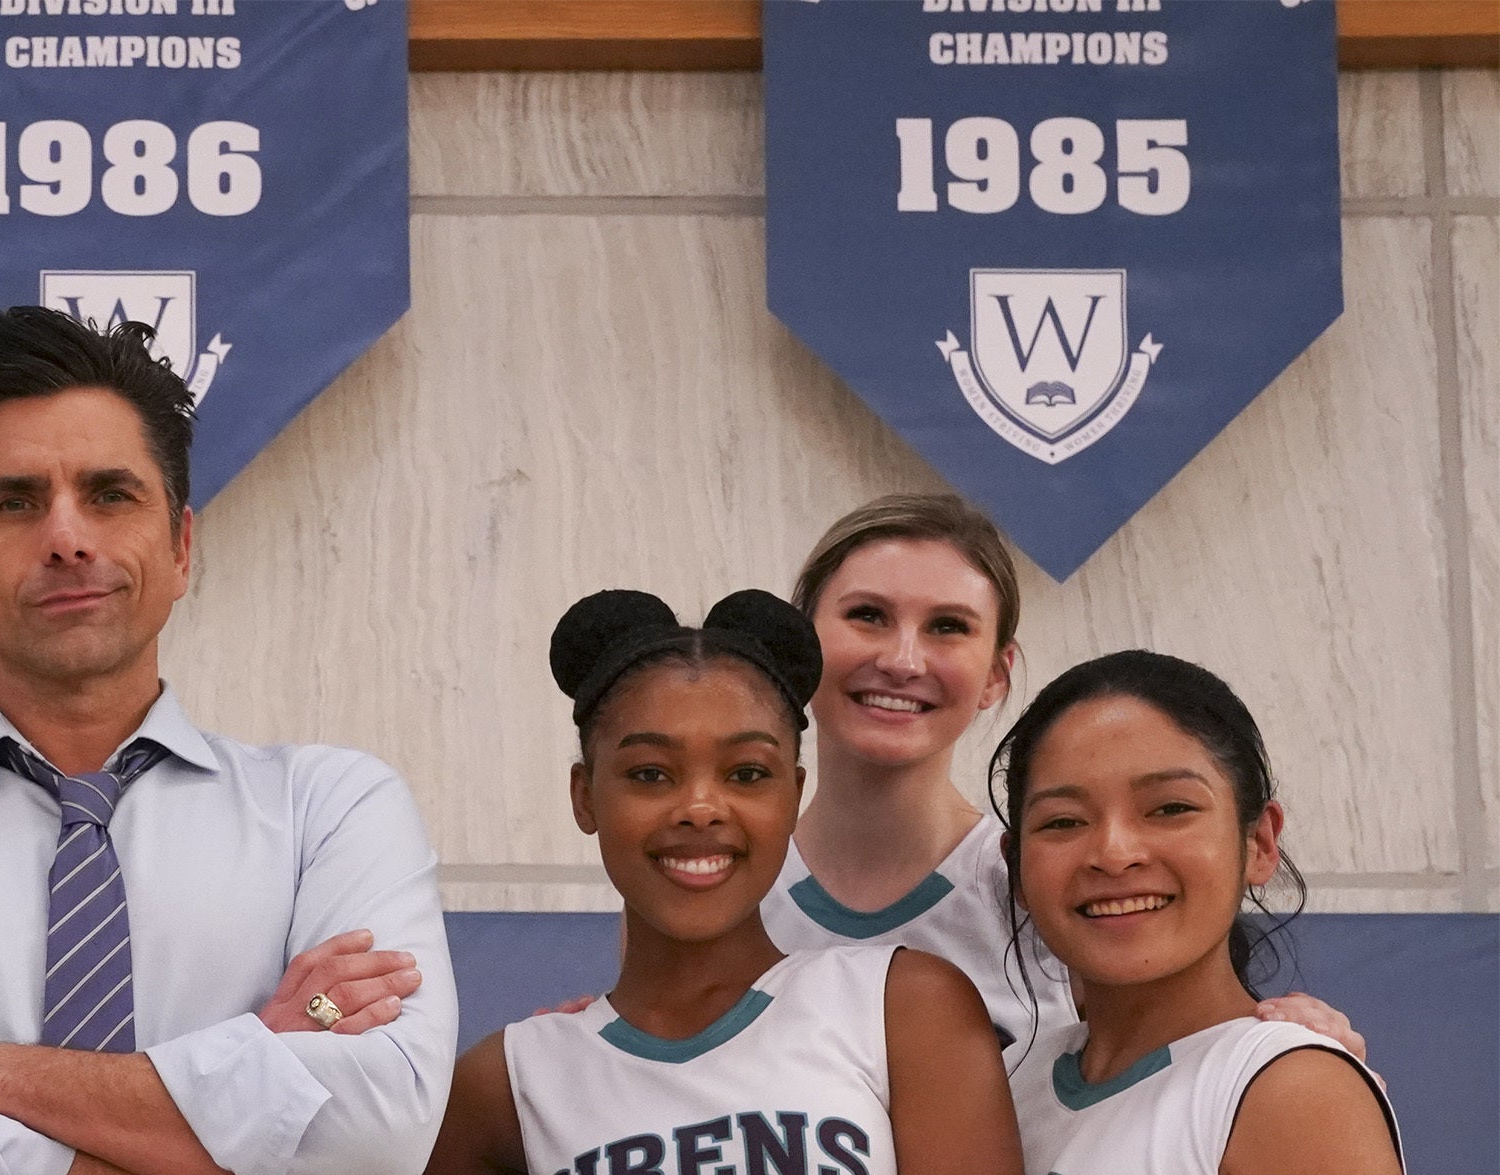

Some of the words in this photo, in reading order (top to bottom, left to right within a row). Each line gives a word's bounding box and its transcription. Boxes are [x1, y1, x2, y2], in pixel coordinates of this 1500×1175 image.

[5, 36, 242, 69] CHAMPIONS
[929, 32, 1169, 65] CHAMPIONS
[896, 117, 1191, 216] 1985
[988, 294, 1107, 373] W
